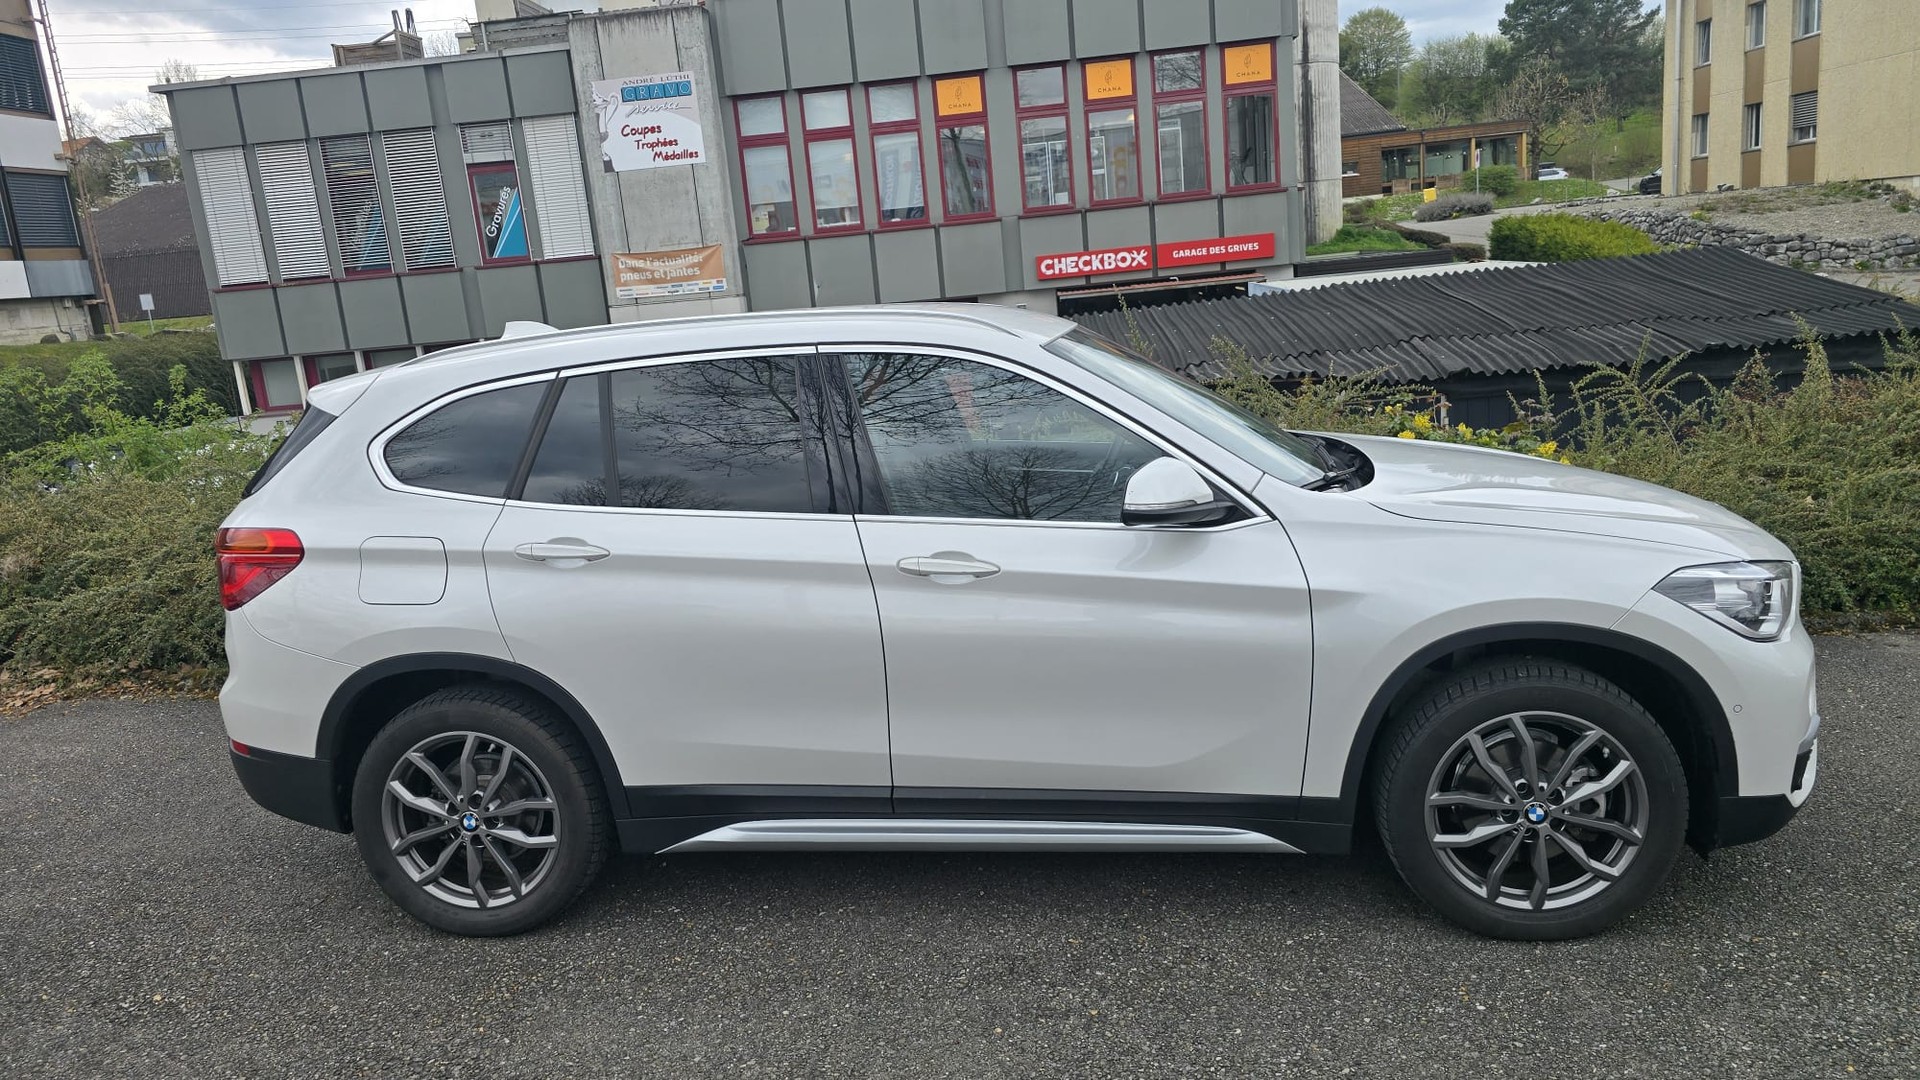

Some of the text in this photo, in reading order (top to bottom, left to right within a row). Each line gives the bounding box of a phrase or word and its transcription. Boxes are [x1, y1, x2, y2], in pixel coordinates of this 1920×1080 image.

[623, 81, 691, 100] GRAVO
[621, 124, 662, 139] Coupes
[634, 138, 679, 152] Trophées
[652, 149, 699, 162] Médailles
[485, 186, 511, 237] Gravures
[1172, 242, 1259, 258] GARAGE DES GRIVES
[618, 258, 646, 269] Dans
[1040, 249, 1148, 275] CHECKBOX
[620, 266, 701, 282] pneus et jantes
